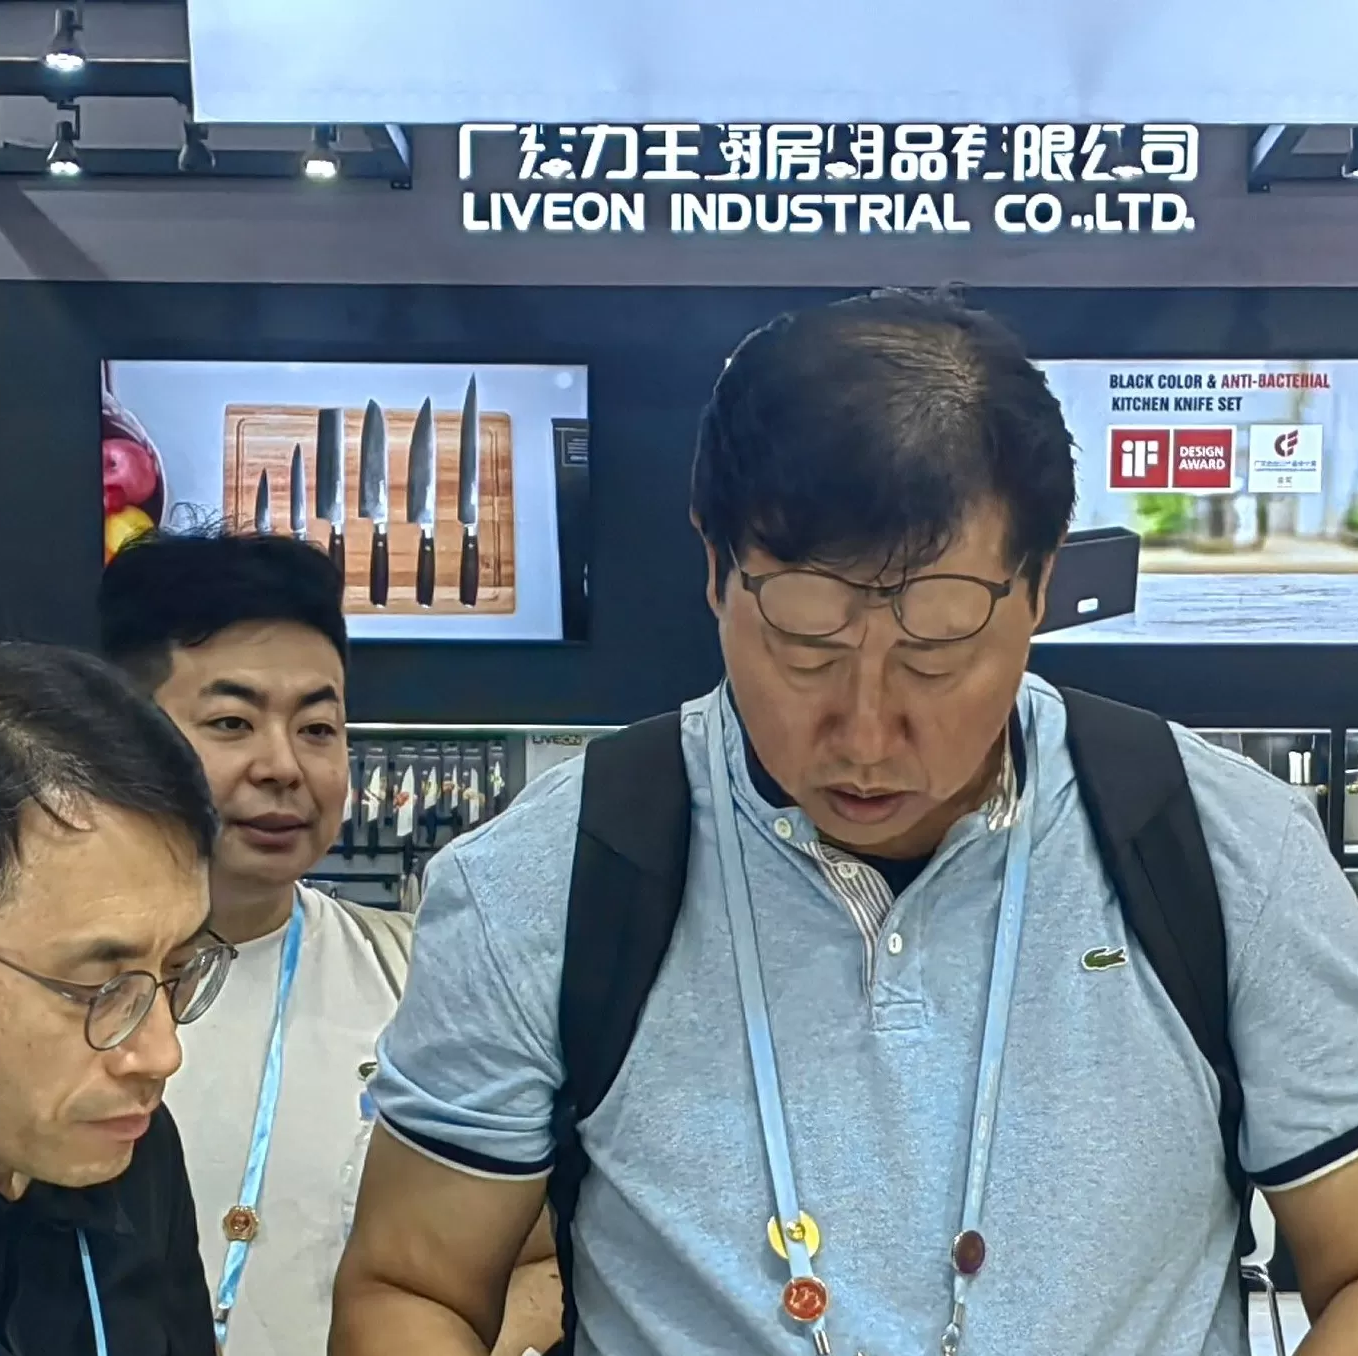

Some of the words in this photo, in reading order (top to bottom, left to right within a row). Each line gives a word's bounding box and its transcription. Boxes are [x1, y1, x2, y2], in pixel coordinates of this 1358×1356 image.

[462, 191, 646, 232] LIVEON
[670, 192, 971, 233] INDUSTRIAL
[1109, 374, 1154, 389] BLACK
[1158, 374, 1202, 389] COLOR
[1206, 374, 1216, 389] &
[1111, 396, 1169, 412] KITCHEN
[1174, 396, 1213, 412] KNIFE
[1218, 396, 1243, 412] SET
[1179, 446, 1224, 458] DESIGN
[1178, 458, 1226, 471] AWARD
